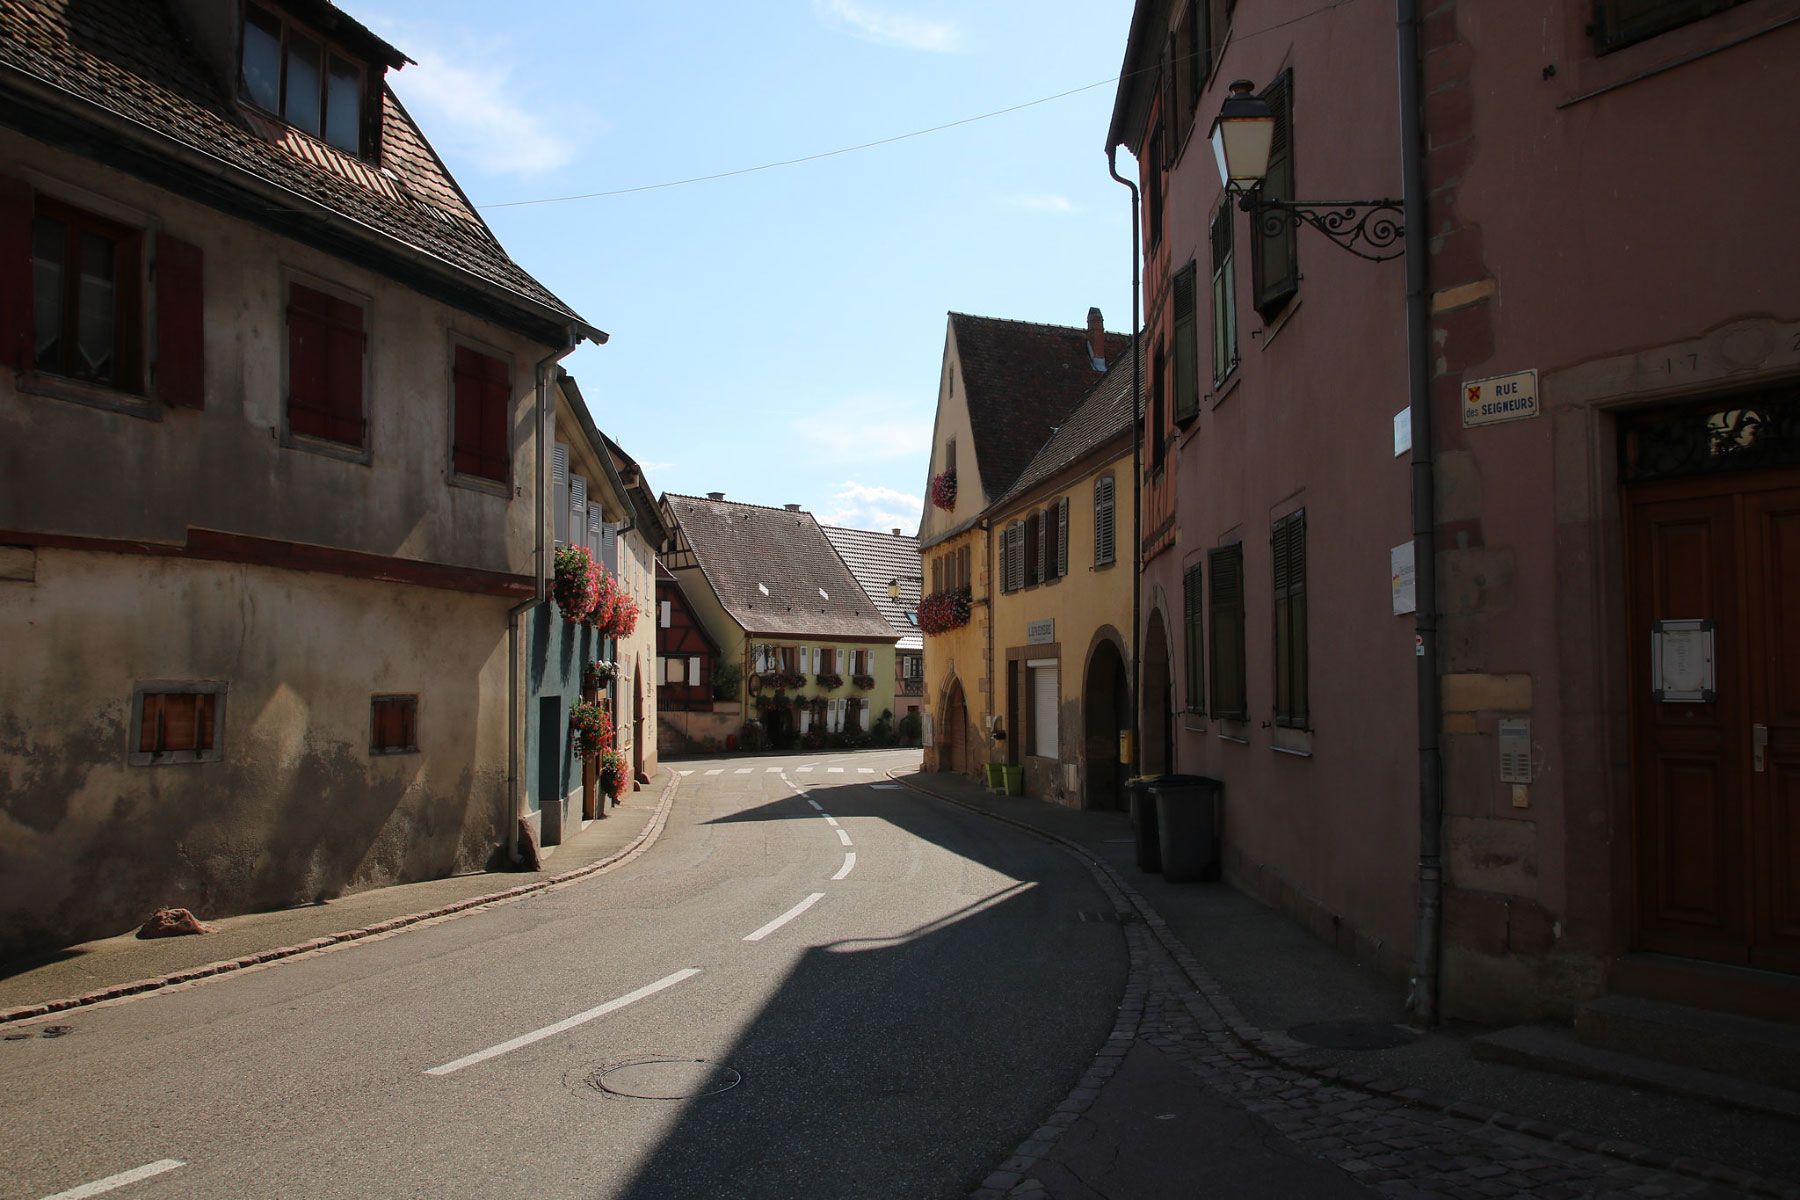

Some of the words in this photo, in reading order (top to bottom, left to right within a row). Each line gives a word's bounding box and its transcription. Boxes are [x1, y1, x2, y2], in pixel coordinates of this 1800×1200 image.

[1496, 382, 1518, 396] RUE
[1466, 408, 1479, 418] des
[1481, 397, 1534, 415] SEIGNEURS
